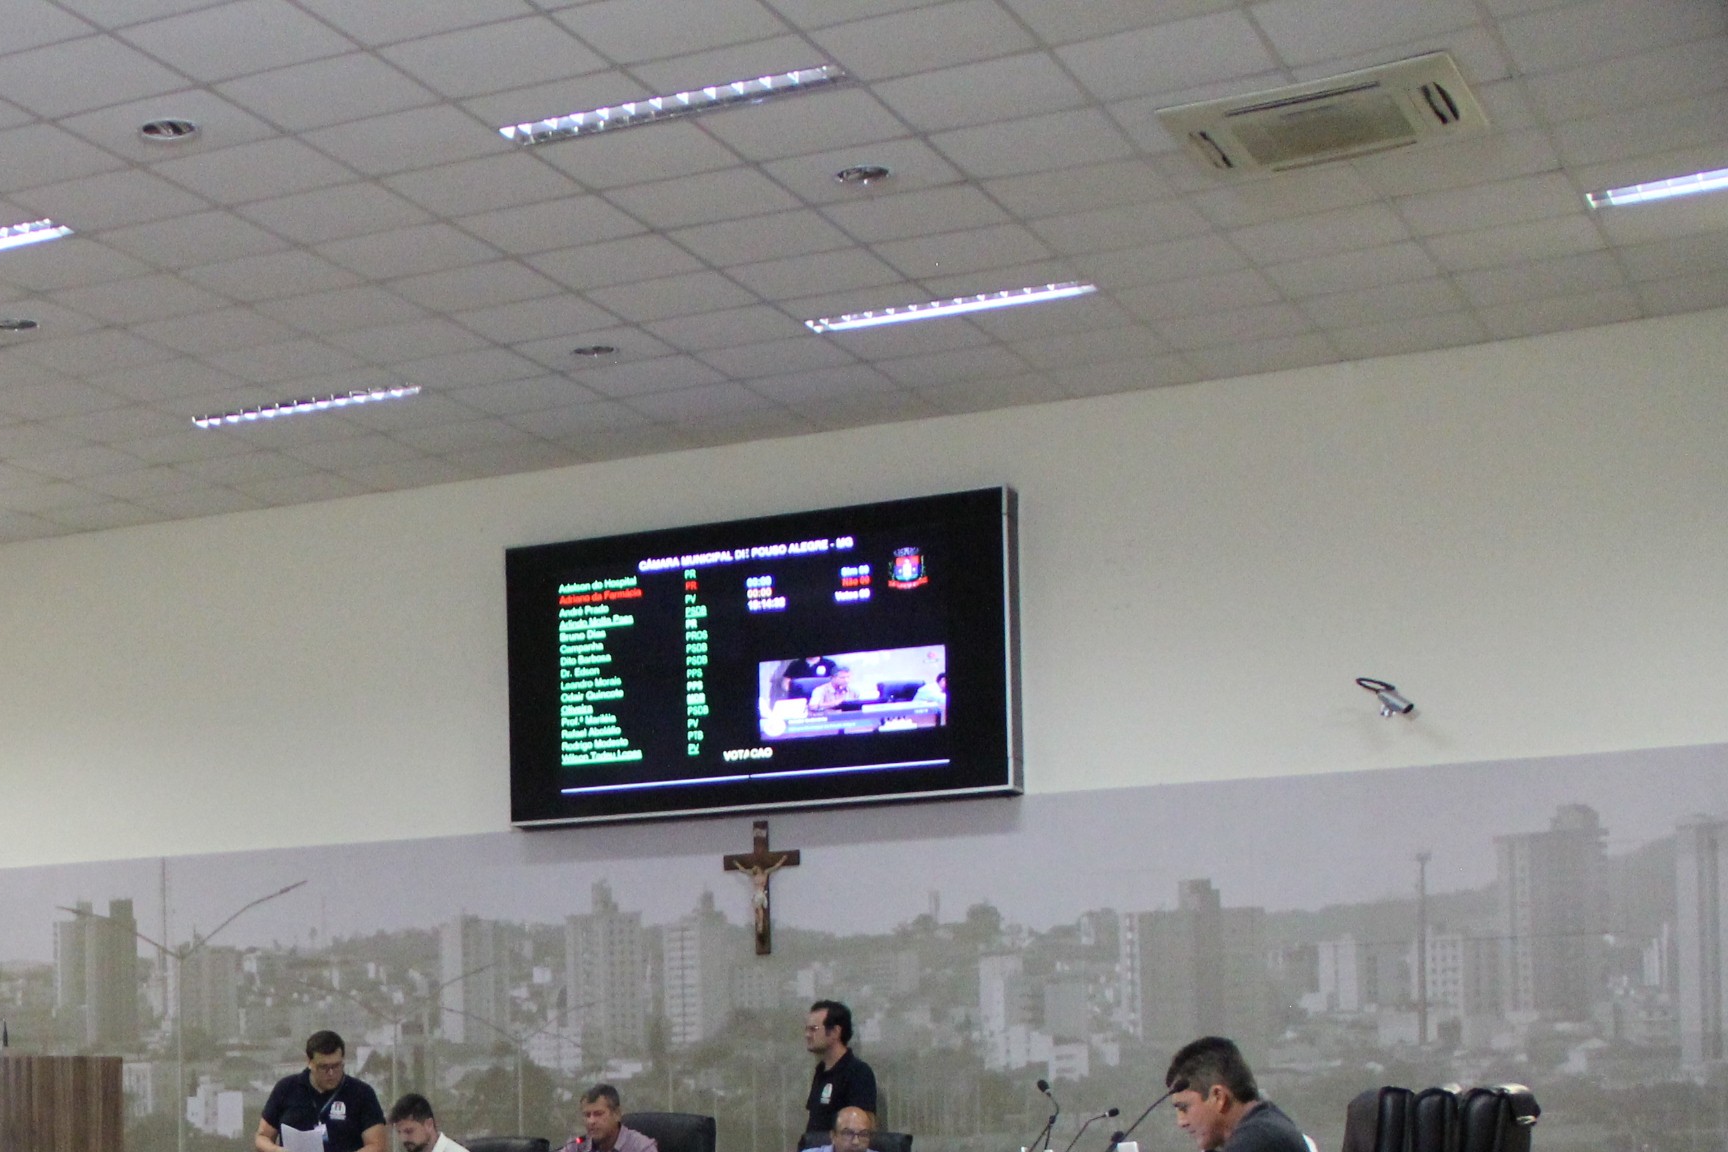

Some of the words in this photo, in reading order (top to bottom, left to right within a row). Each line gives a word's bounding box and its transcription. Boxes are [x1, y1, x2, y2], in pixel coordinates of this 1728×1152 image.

[681, 551, 733, 567] MUNICIPAL
[751, 544, 787, 558] POUSO
[788, 539, 829, 554] ALEGRE
[836, 536, 854, 549] MG
[684, 568, 696, 579] PR
[604, 575, 637, 589] Hospital
[685, 580, 698, 591] PR
[559, 594, 591, 605] Adriano
[591, 592, 603, 602] da
[603, 588, 642, 600] Farmácia
[685, 593, 696, 604] PV
[747, 587, 772, 599] 00:00
[559, 606, 583, 618] André
[584, 604, 609, 615] Prado
[685, 605, 707, 618] PSDB
[685, 618, 698, 630] PR
[559, 632, 585, 643] Bruno
[586, 629, 606, 640] Dias
[686, 630, 708, 641] PROS
[560, 641, 604, 654] Campanha
[686, 642, 708, 654] PSDB
[560, 656, 577, 667] Dito
[577, 654, 612, 665] Barbosa
[686, 654, 708, 666] PSDB
[560, 668, 572, 679] Dr.
[574, 667, 600, 678] Edson
[686, 668, 703, 679] PPS
[560, 679, 593, 691] Leandro
[594, 676, 622, 688] Morais
[686, 680, 703, 692] PPS
[560, 692, 584, 703] Odair
[560, 703, 593, 716] Oliveira
[687, 705, 709, 716] PSDB
[687, 718, 699, 729] PV
[561, 728, 587, 739] Rafael
[687, 730, 704, 741] PTB
[561, 740, 593, 752] Rodrigo
[593, 737, 629, 749] Modesto
[687, 743, 700, 755] PV
[561, 753, 589, 766] Wilson
